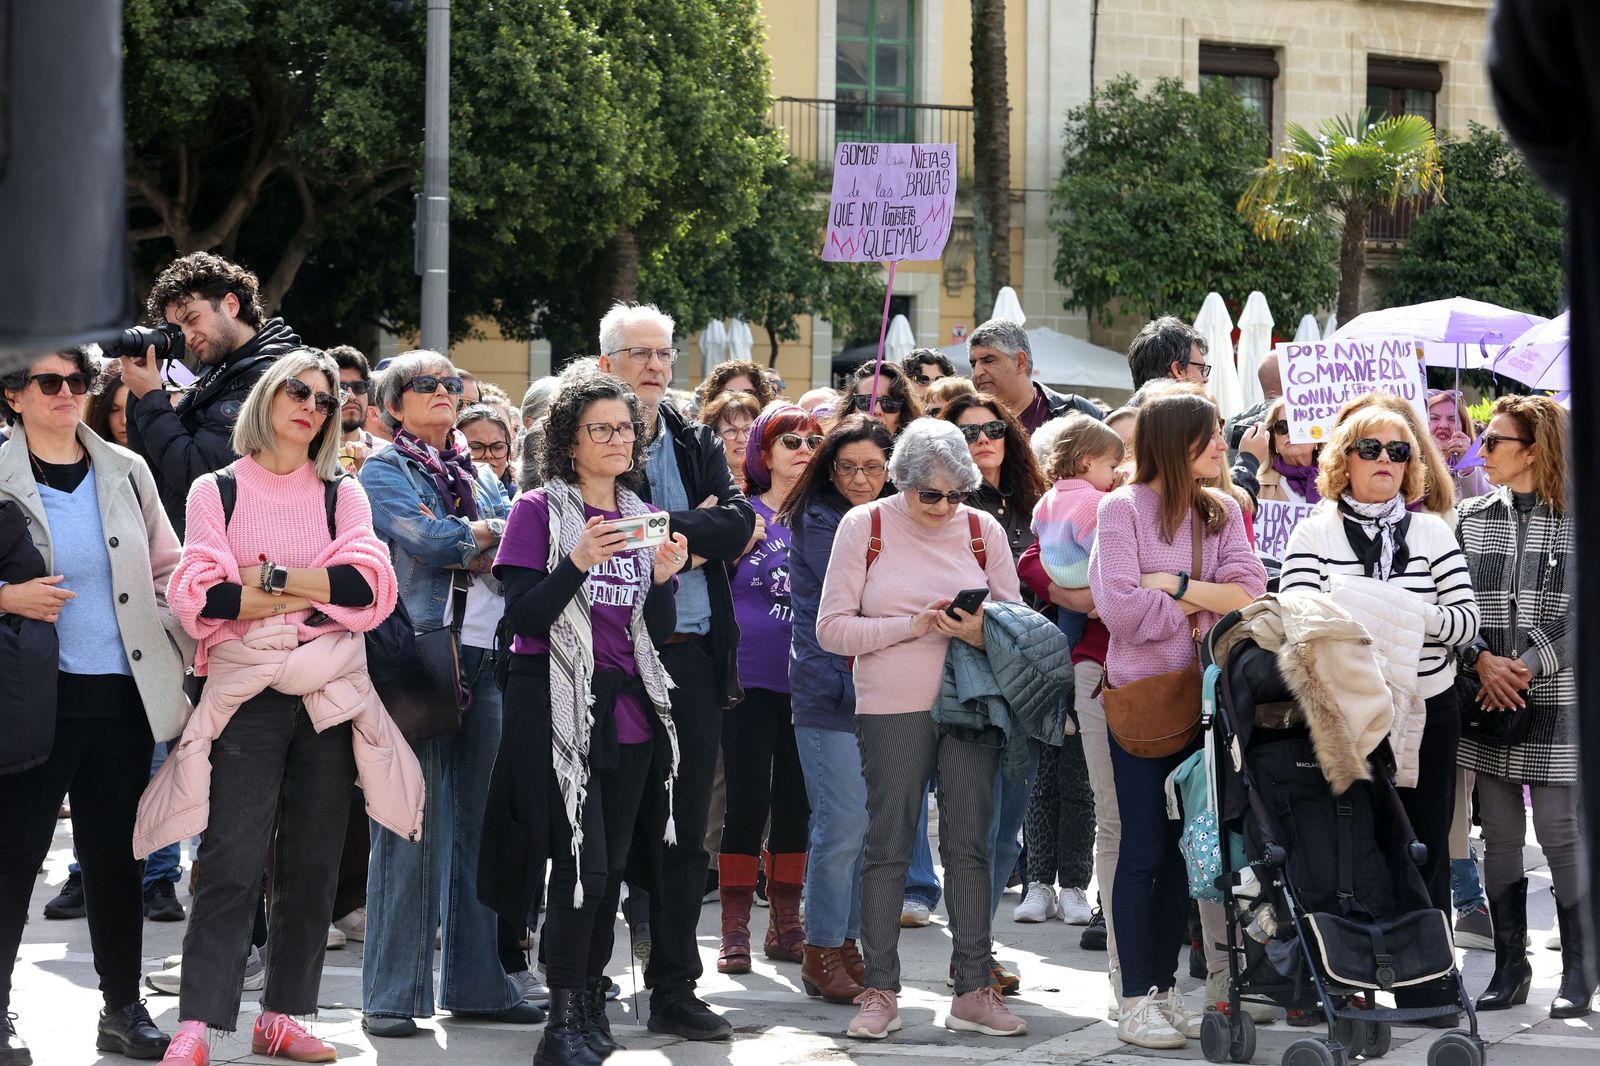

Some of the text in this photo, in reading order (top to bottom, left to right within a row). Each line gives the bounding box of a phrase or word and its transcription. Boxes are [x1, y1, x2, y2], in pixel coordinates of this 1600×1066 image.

[840, 144, 879, 166] SOMOS
[848, 169, 950, 200] de las BRUJAS
[833, 202, 856, 228] QUE
[860, 201, 877, 226] NO
[863, 225, 928, 260] QUEMAR
[1286, 344, 1328, 362] POR
[1380, 339, 1412, 359] MIS
[205, 362, 227, 387] SONY
[749, 549, 768, 566] NI
[766, 538, 786, 552] UN
